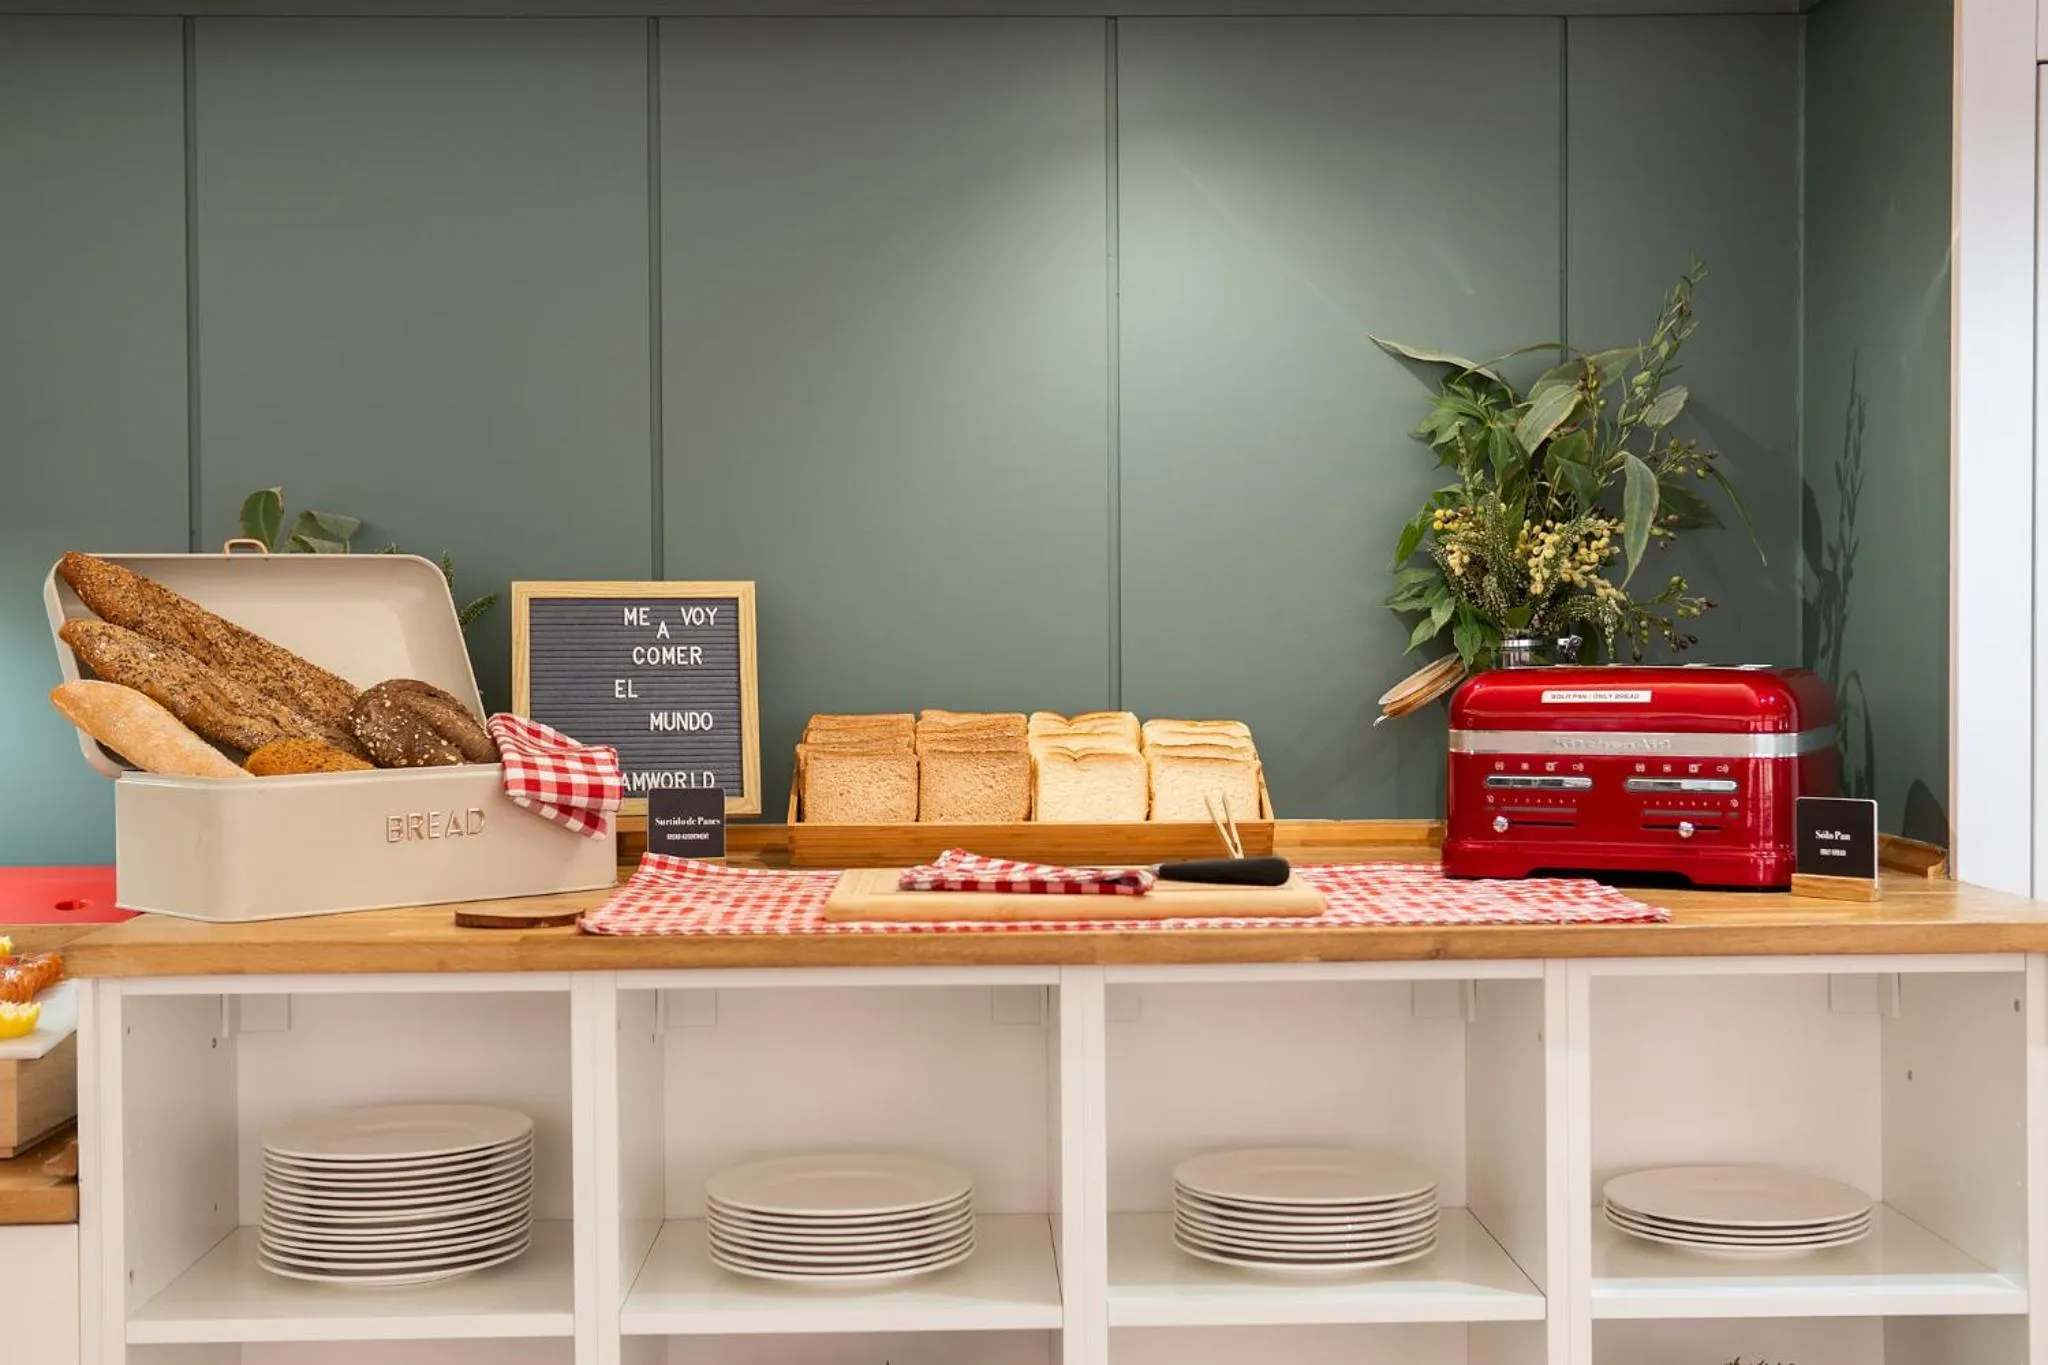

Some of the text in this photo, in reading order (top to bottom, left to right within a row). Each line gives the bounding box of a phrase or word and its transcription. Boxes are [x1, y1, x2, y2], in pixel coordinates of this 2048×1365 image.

[624, 607, 718, 626] ME VOY
[656, 620, 670, 639] A
[632, 646, 703, 665] COMER
[614, 679, 638, 698] EL
[650, 712, 713, 731] MUNDO
[385, 808, 486, 843] BREAD
[655, 816, 685, 826] Surtido
[686, 816, 697, 825] de
